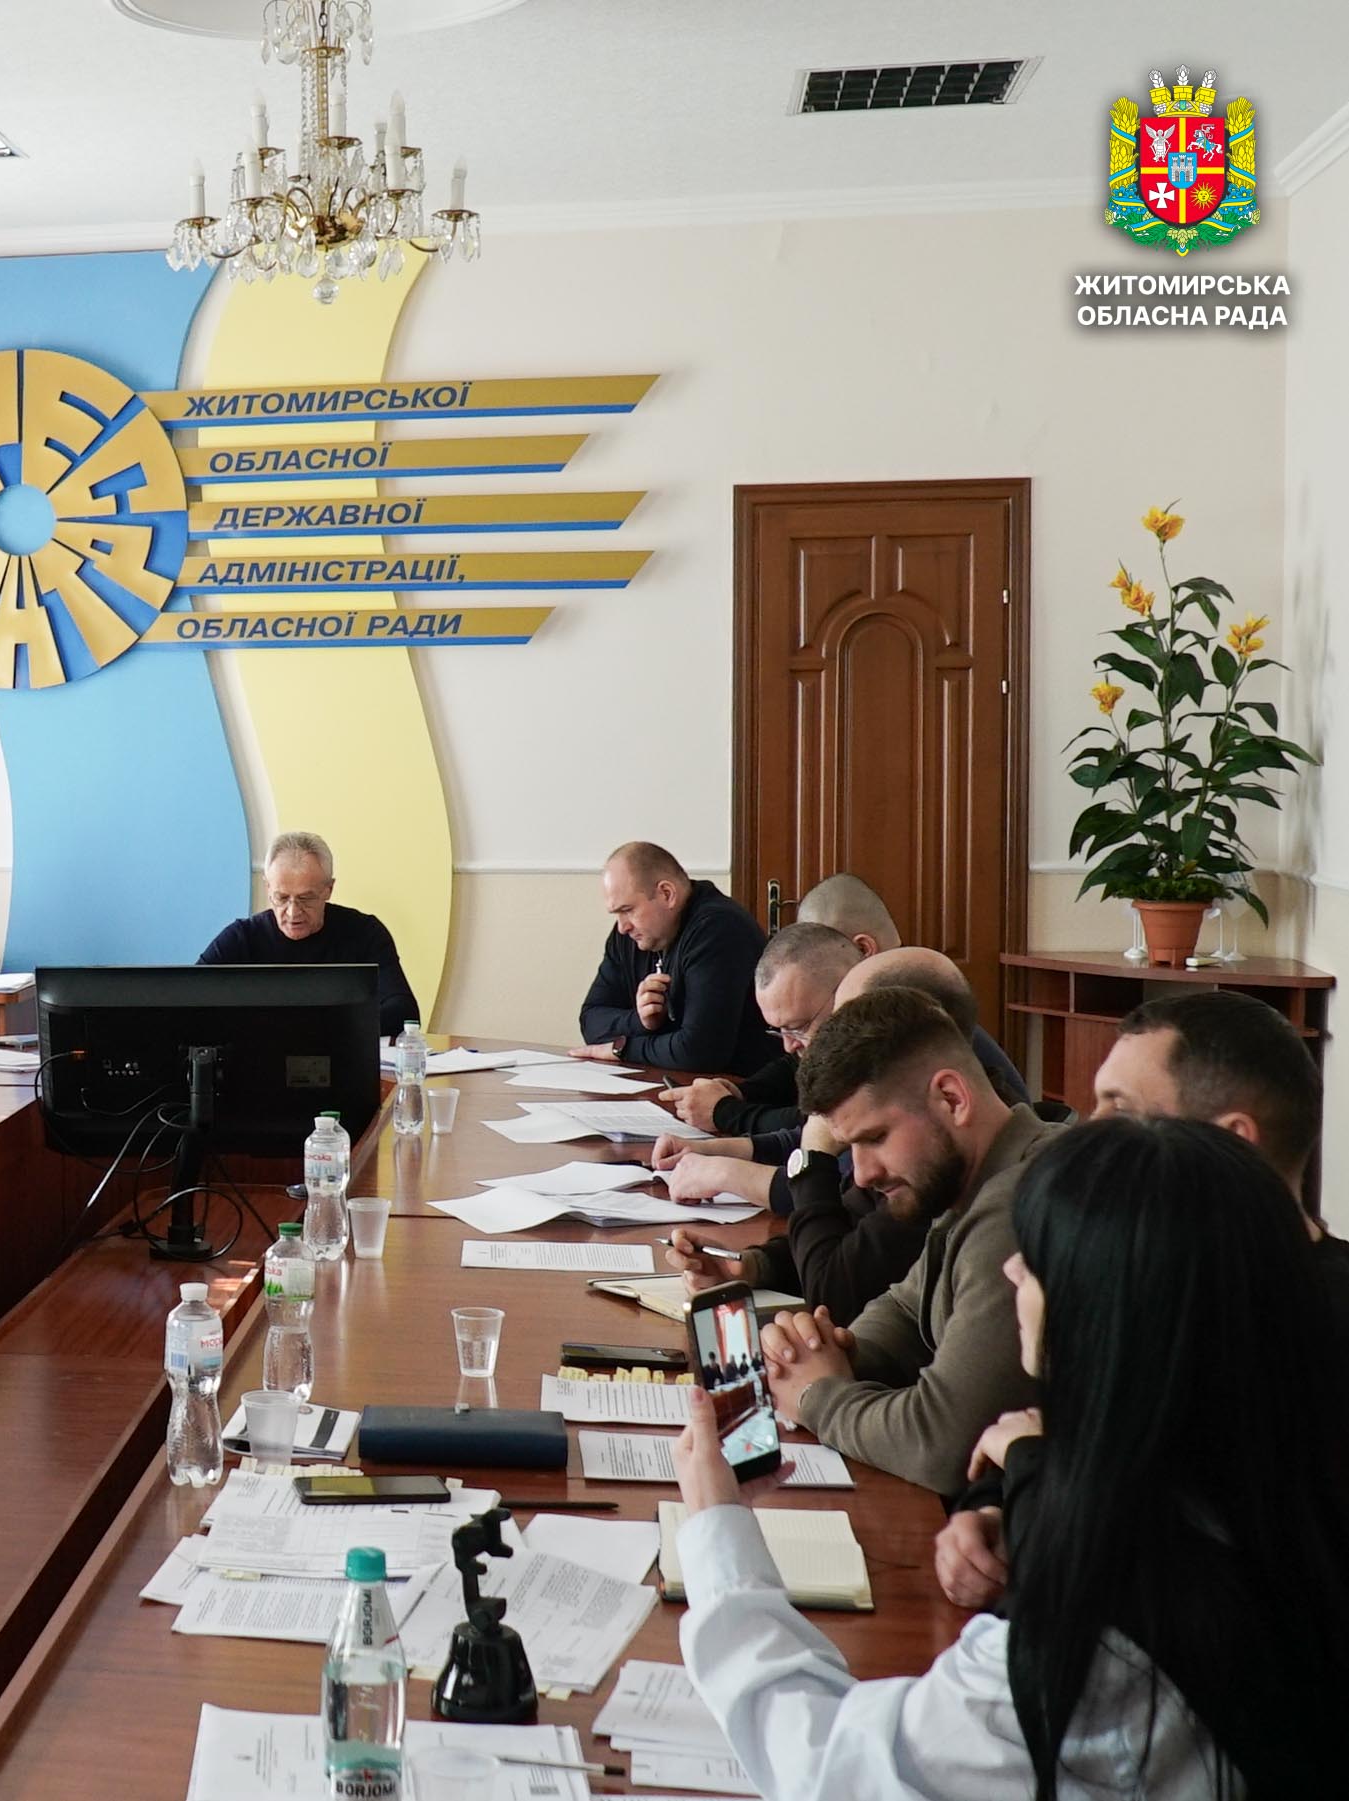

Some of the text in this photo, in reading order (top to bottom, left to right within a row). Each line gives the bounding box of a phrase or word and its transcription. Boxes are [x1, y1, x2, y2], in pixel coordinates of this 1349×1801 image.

[183, 382, 472, 417] ЖИТОМИРСЬКОЇ
[209, 442, 392, 473] ОБЛАСНОЇ
[213, 499, 427, 530] ДЕРЖАВНОЇ
[198, 555, 465, 585] АДМІНІСТРАЦІЇ,
[177, 612, 462, 639] ОБЛАСНОЇ РАДИ
